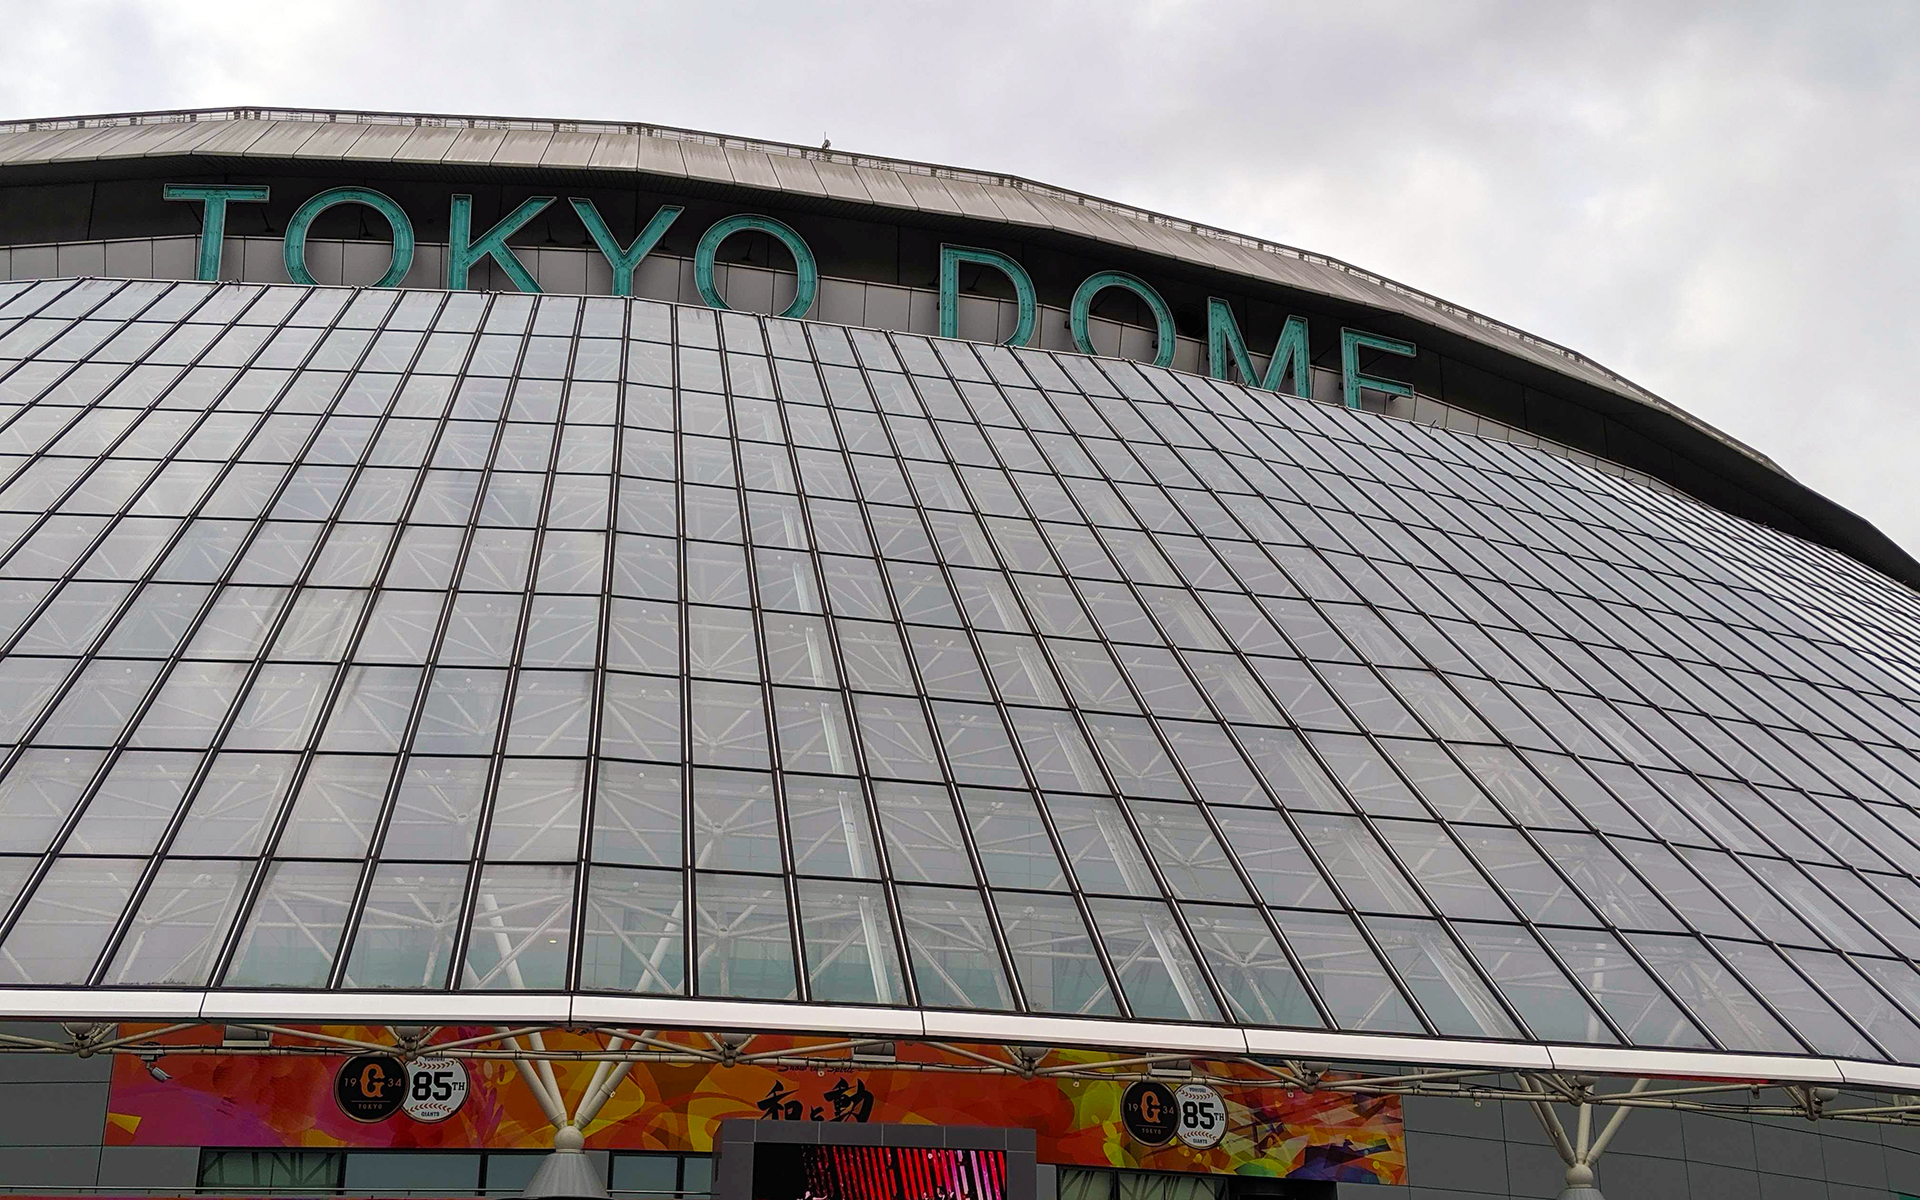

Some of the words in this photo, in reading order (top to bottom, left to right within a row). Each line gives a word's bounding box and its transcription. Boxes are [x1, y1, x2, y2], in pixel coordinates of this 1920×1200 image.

[163, 184, 818, 318] TOKYO
[939, 242, 1417, 409] DOME
[344, 1077, 357, 1087] 19
[360, 1063, 385, 1098] G
[387, 1078, 402, 1088] 34
[757, 1079, 874, 1122] 和と動
[1128, 1103, 1139, 1112] 19
[1140, 1091, 1161, 1123] G
[1162, 1106, 1174, 1114] 34
[1142, 1127, 1162, 1135] TOKYO
